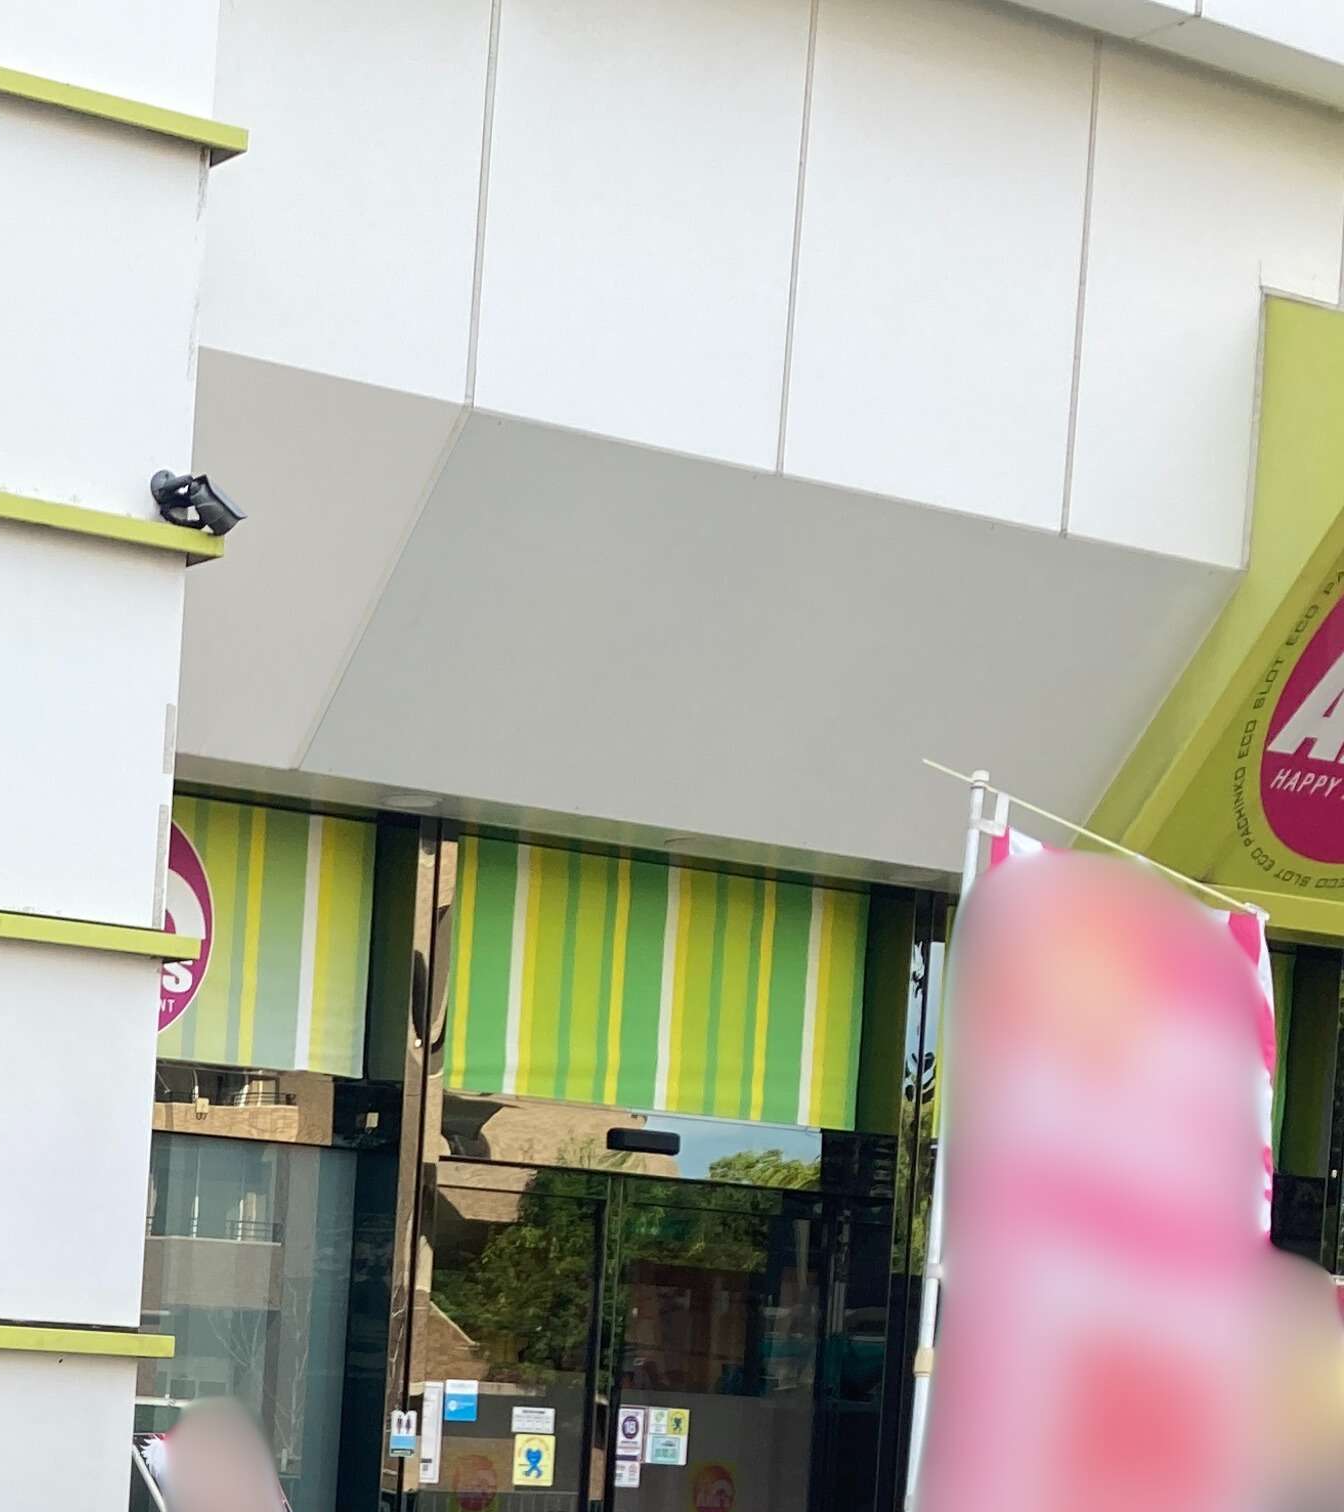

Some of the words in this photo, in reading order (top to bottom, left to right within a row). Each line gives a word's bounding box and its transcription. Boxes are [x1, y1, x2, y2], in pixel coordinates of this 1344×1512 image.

[1286, 604, 1320, 646] ECO
[1238, 719, 1257, 759] ECO
[1270, 768, 1344, 798] HAPPY
[1233, 766, 1256, 847] PACHINKO
[1250, 847, 1276, 872] ECO
